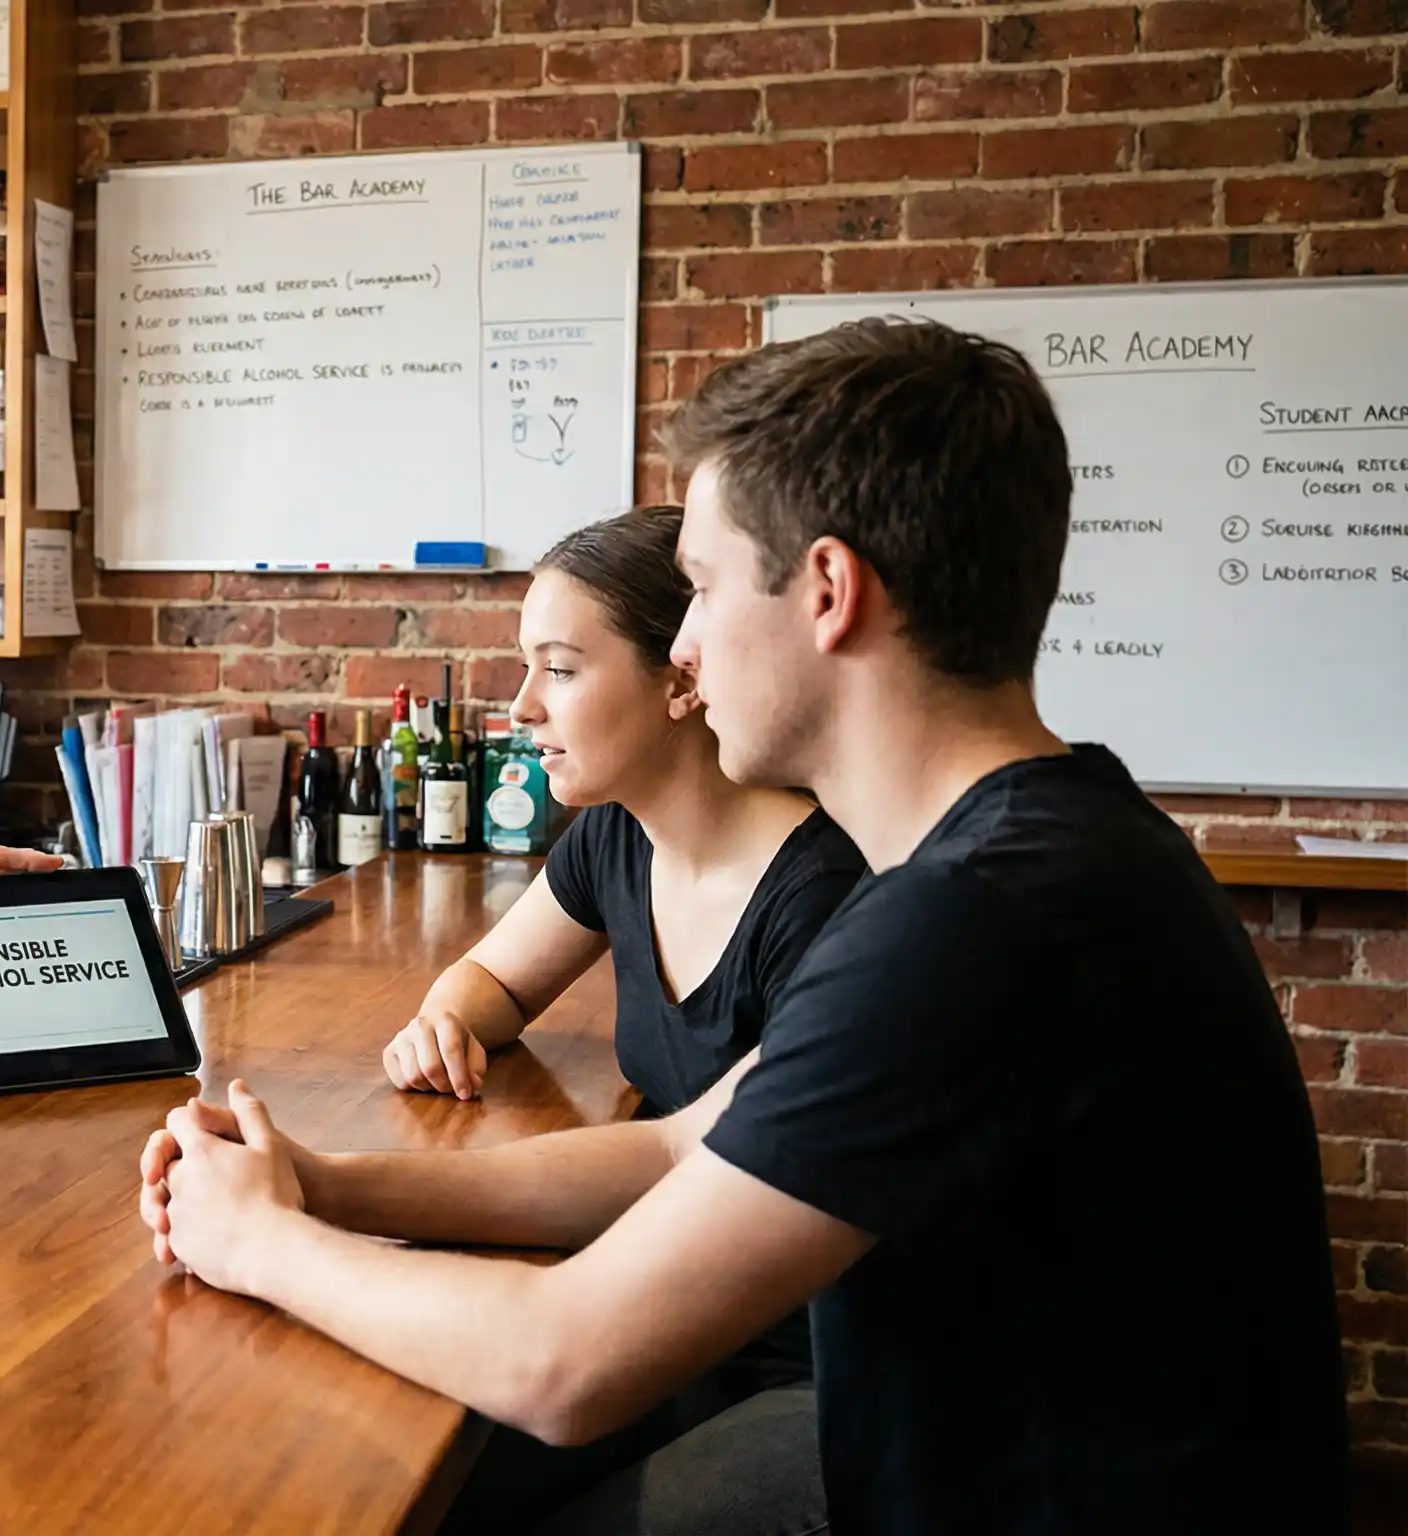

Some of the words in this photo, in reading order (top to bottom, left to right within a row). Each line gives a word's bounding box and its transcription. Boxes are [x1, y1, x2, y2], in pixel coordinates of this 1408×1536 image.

[248, 183, 287, 206] THE
[301, 181, 338, 203] BAR
[349, 178, 426, 200] ACADEMY
[1045, 332, 1109, 367] BAR
[1125, 331, 1254, 363] ACADEMY
[138, 369, 232, 388] RESPONSIBLE
[243, 367, 304, 382] ALCOHOL
[312, 364, 369, 380] SERVICE
[381, 364, 394, 376] IS
[1260, 401, 1352, 425] STUDENT
[1372, 482, 1396, 493] OR
[39, 960, 130, 985] SERVICE
